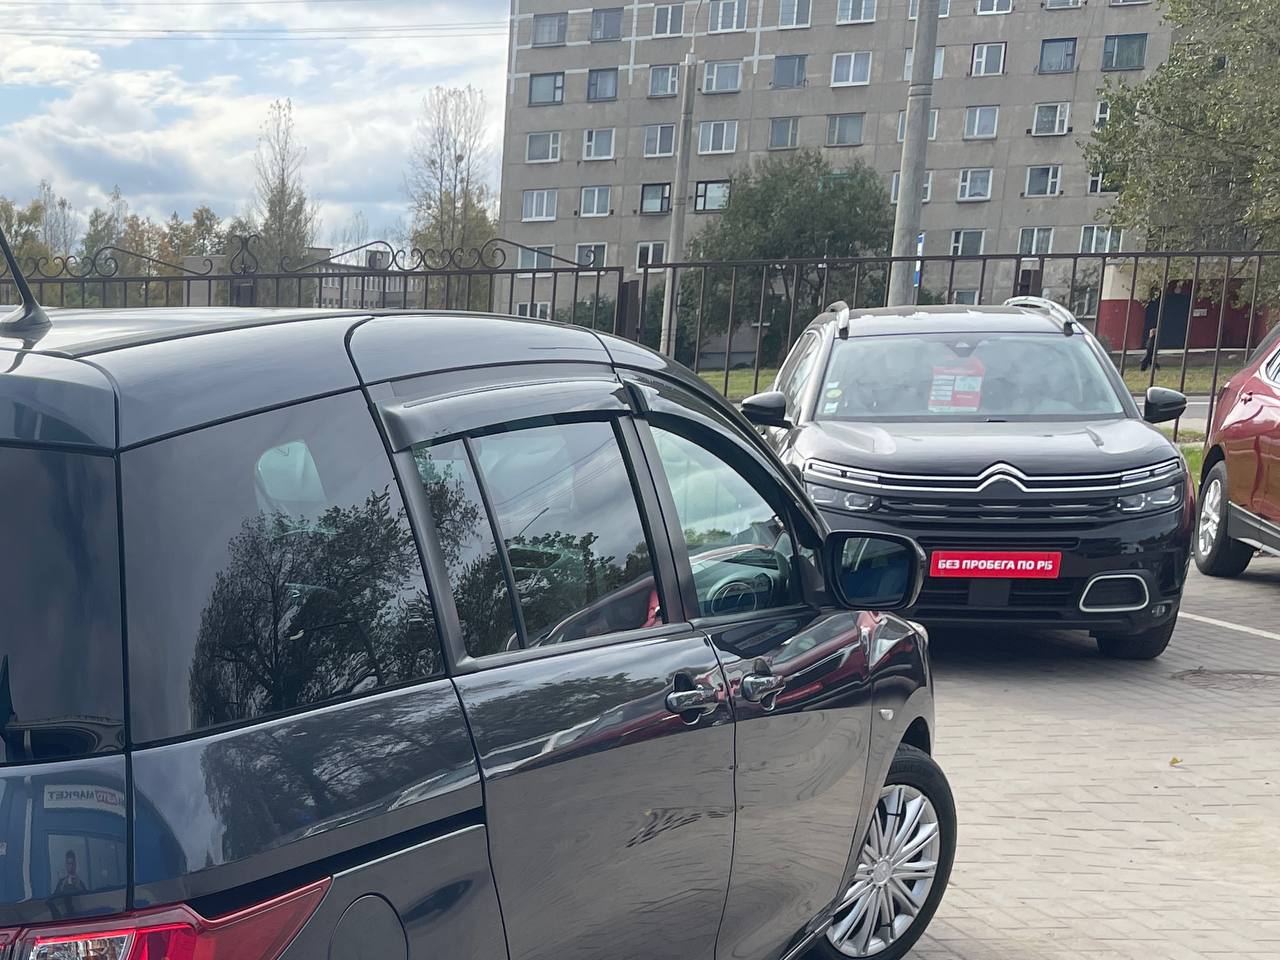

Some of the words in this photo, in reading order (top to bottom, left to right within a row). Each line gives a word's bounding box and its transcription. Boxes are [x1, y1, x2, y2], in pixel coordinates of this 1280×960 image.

[938, 559, 960, 570] БЕЗ
[962, 559, 1015, 570] ПРОБЕГА
[1017, 560, 1035, 570] ПО
[1037, 560, 1054, 571] РБ
